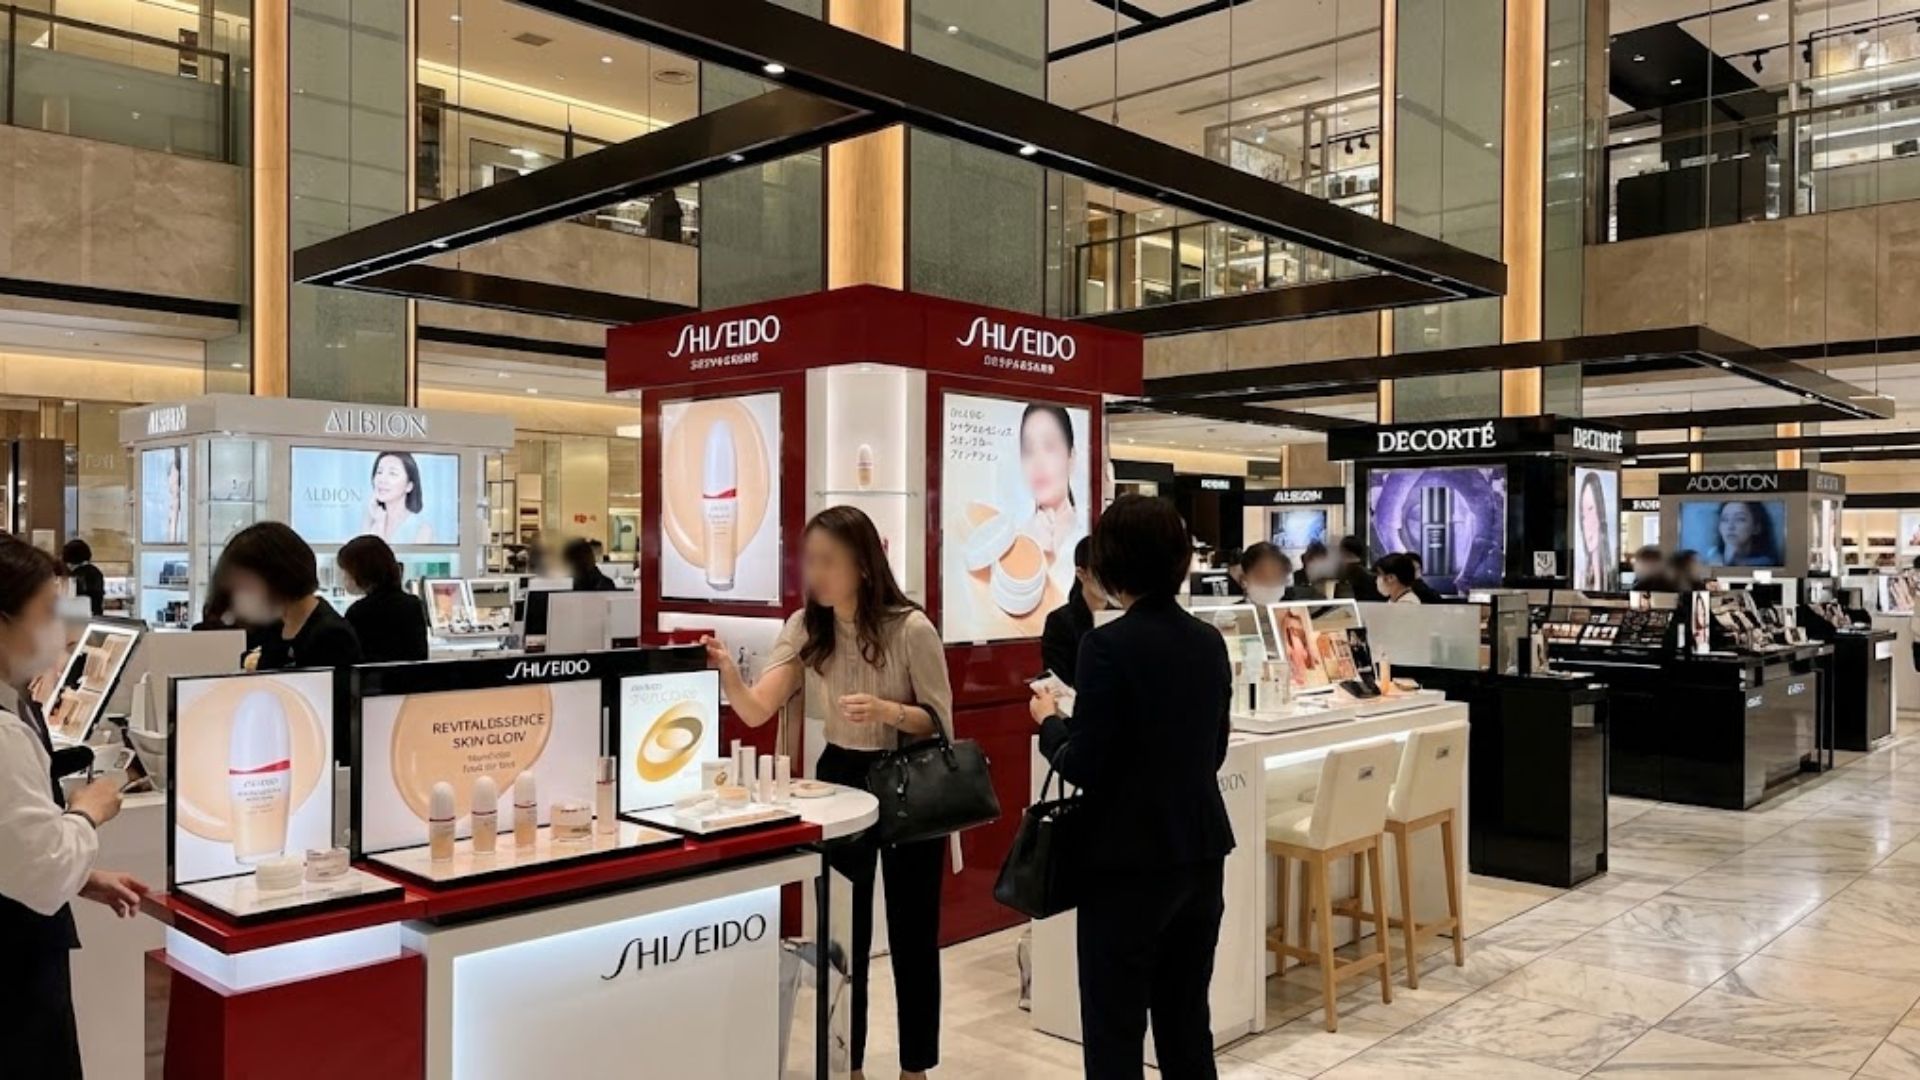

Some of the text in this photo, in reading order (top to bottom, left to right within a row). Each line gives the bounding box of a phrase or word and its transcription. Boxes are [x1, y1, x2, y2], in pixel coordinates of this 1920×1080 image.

[667, 315, 780, 357] SHISEIDO
[956, 316, 1076, 361] SHISEIDO
[325, 408, 427, 438] ALBION
[1377, 421, 1497, 452] DECORTÉ
[1686, 474, 1778, 491] ADDICTION
[506, 659, 591, 679] SHISEIDO
[452, 735, 485, 749] SKIN
[601, 913, 767, 980] SHISEIDO
